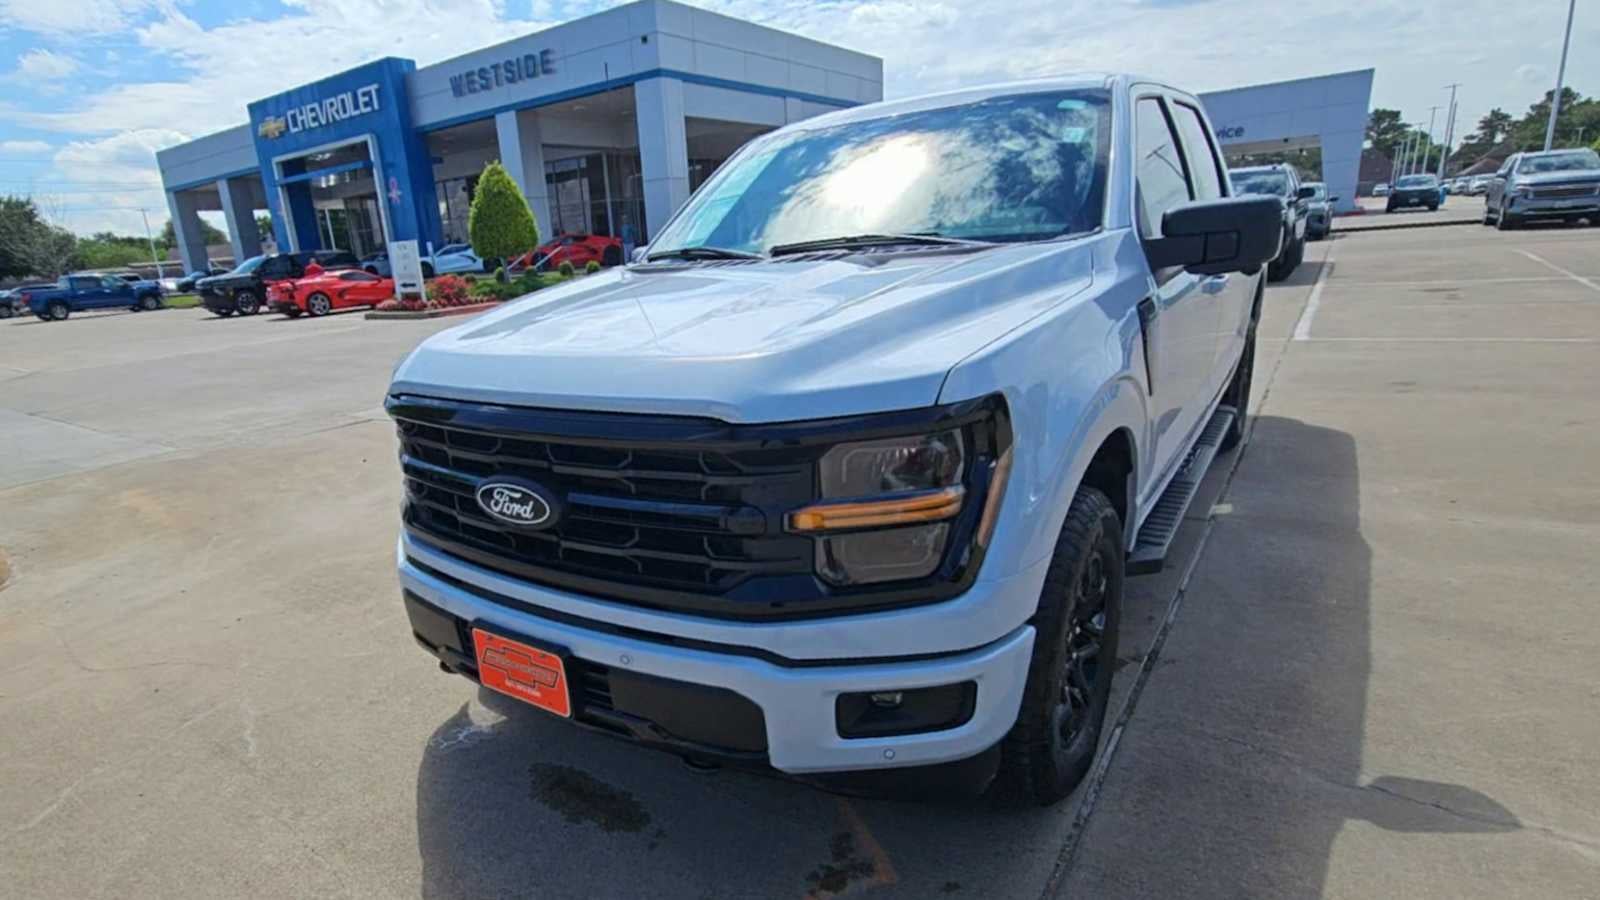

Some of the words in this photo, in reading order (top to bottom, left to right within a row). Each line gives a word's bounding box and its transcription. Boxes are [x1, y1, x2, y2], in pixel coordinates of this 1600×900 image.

[450, 48, 556, 97] WESTSIDE
[286, 84, 380, 133] CHEVROLET
[1216, 125, 1245, 139] vice
[491, 488, 534, 519] Ford
